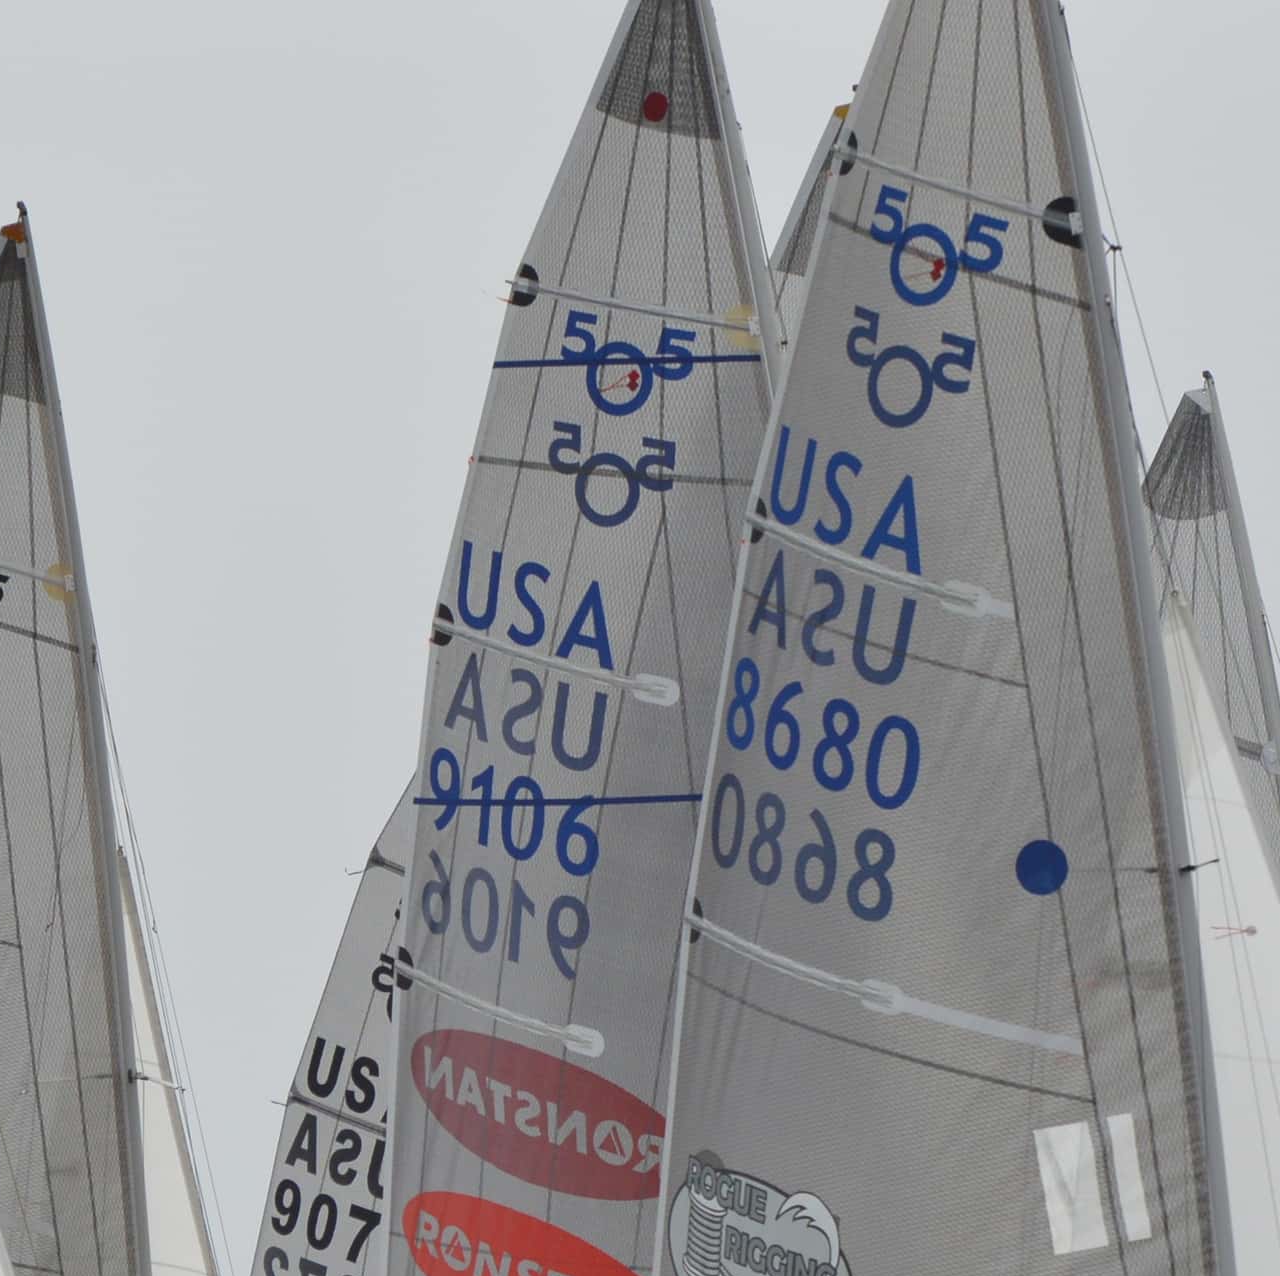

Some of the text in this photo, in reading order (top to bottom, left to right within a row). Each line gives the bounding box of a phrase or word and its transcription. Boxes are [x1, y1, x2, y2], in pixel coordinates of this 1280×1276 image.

[770, 425, 921, 574] USA
[457, 541, 613, 670] USA
[726, 657, 920, 809] 8680
[429, 747, 598, 876] 9106
[307, 1037, 388, 1122] US
[687, 1154, 768, 1224] ROGUE
